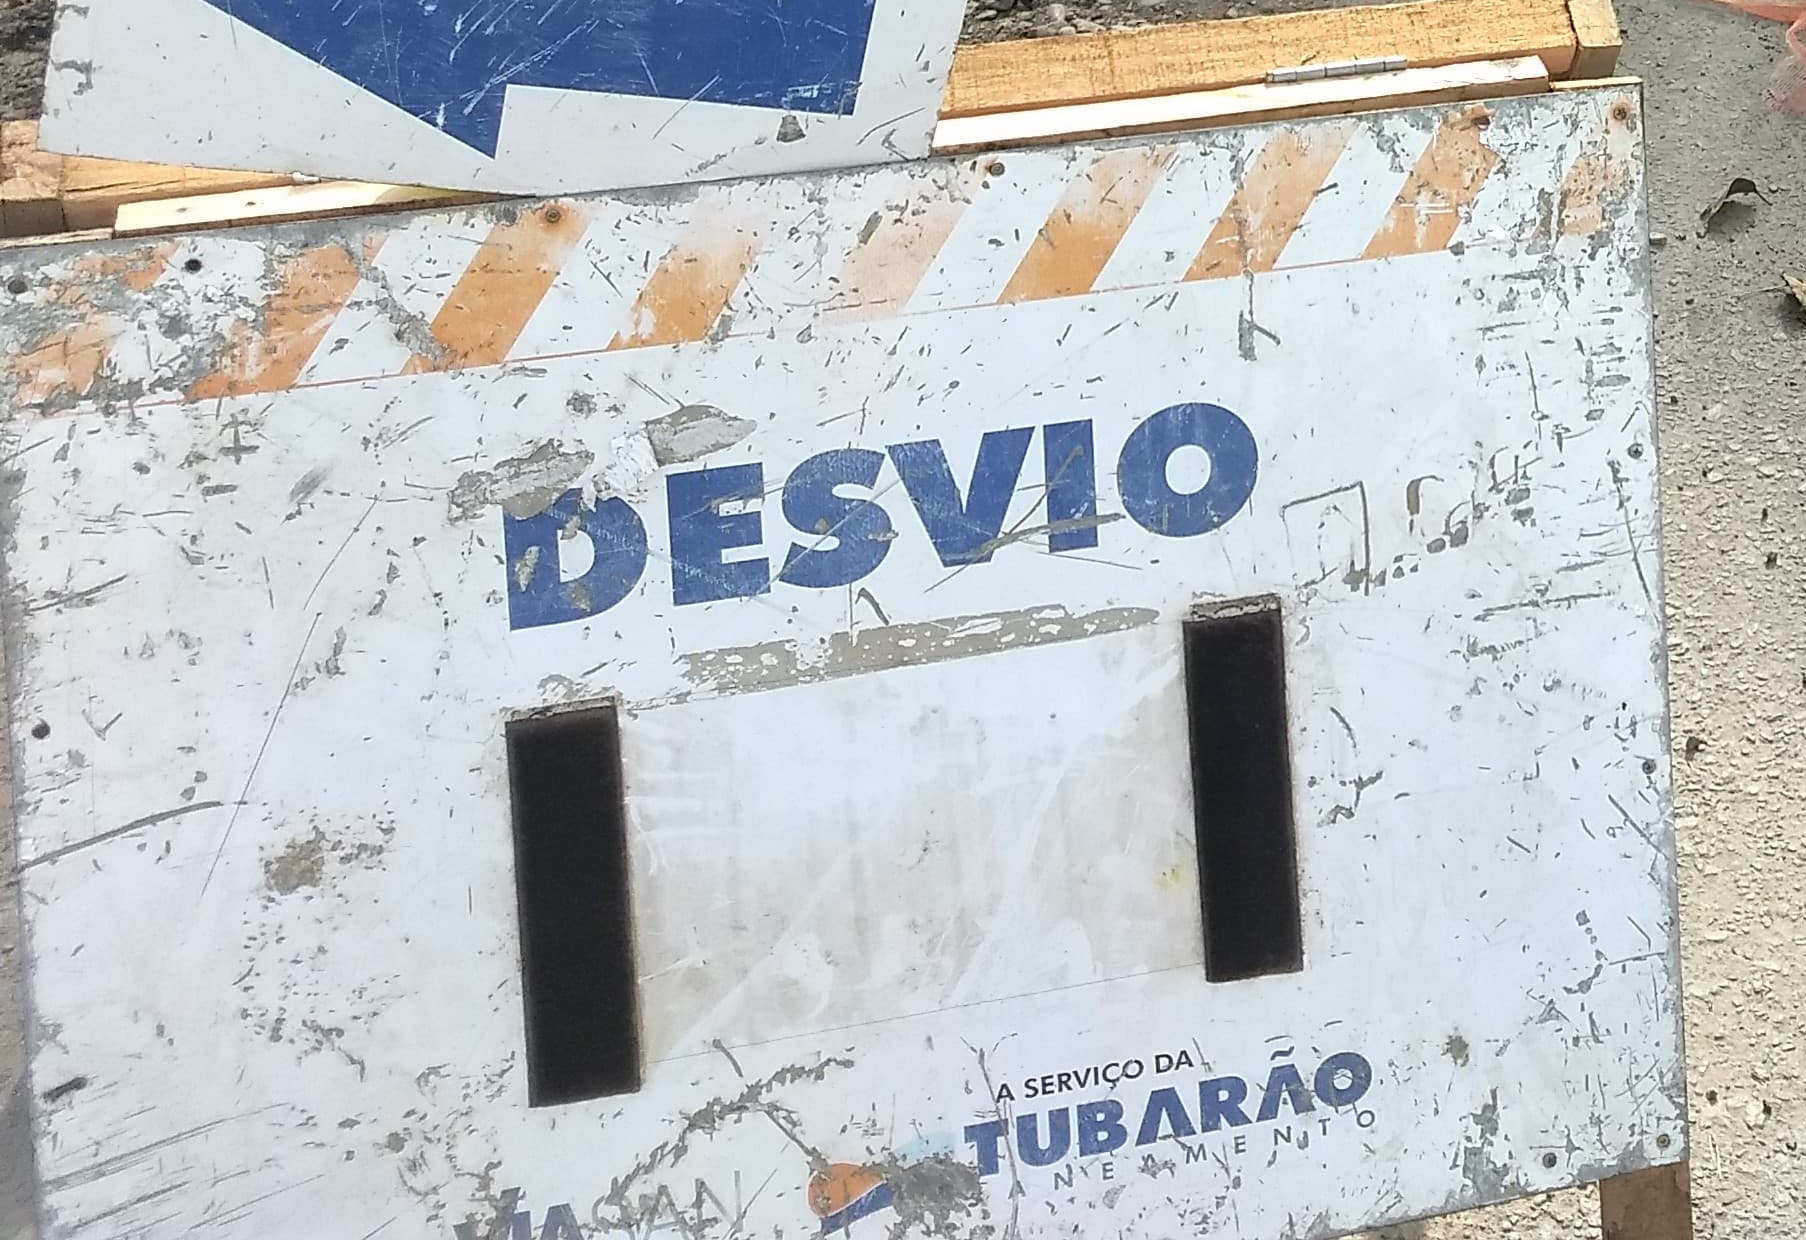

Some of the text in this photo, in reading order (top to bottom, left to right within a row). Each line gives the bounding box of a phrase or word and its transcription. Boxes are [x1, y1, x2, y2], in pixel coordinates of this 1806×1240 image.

[503, 402, 1258, 630] DESVIO
[964, 1046, 1372, 1176] TUBARÃO
[998, 1050, 1194, 1102] A SERVIÇO DA
